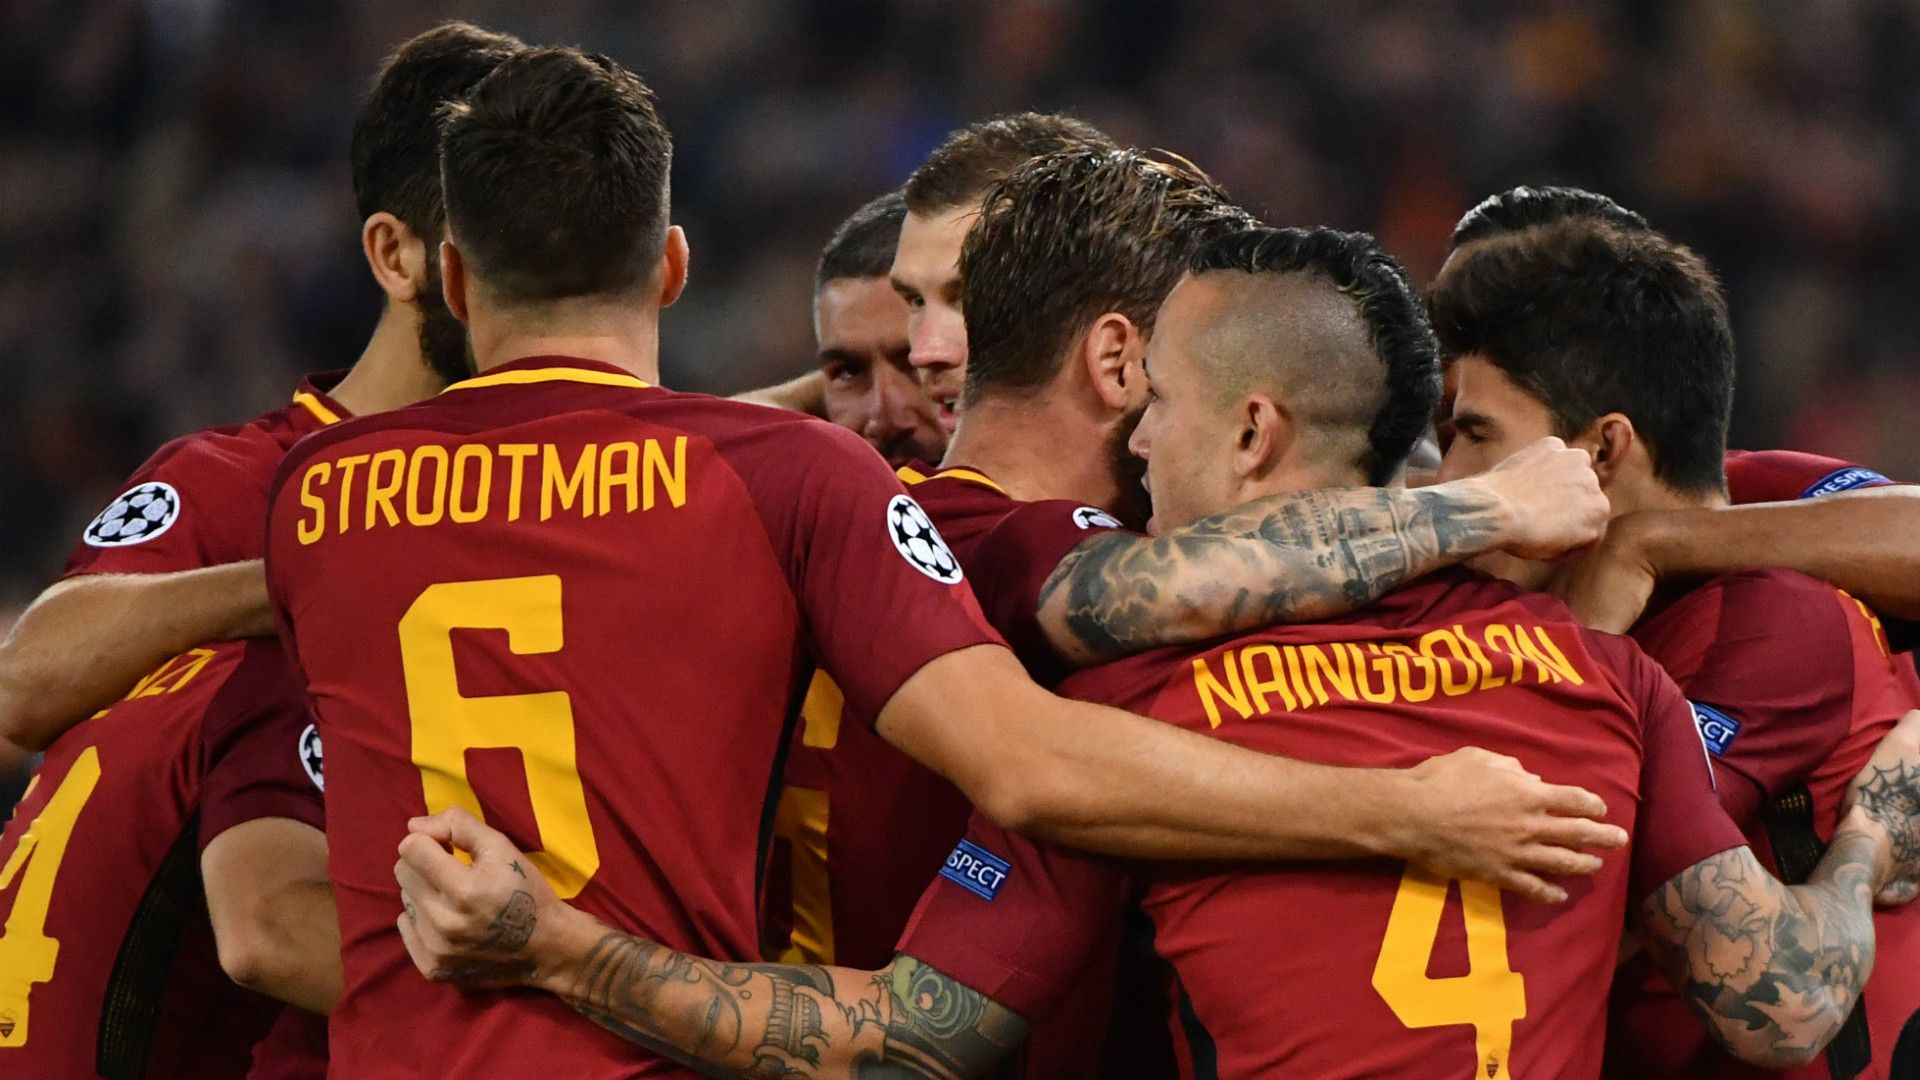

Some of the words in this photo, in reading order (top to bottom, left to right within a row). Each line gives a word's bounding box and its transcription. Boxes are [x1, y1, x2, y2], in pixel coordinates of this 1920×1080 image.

[297, 436, 688, 545] STROOTMAN
[398, 574, 600, 900] 6
[1192, 624, 1584, 729] NAINGGOLAN
[1371, 860, 1527, 1080] 4
